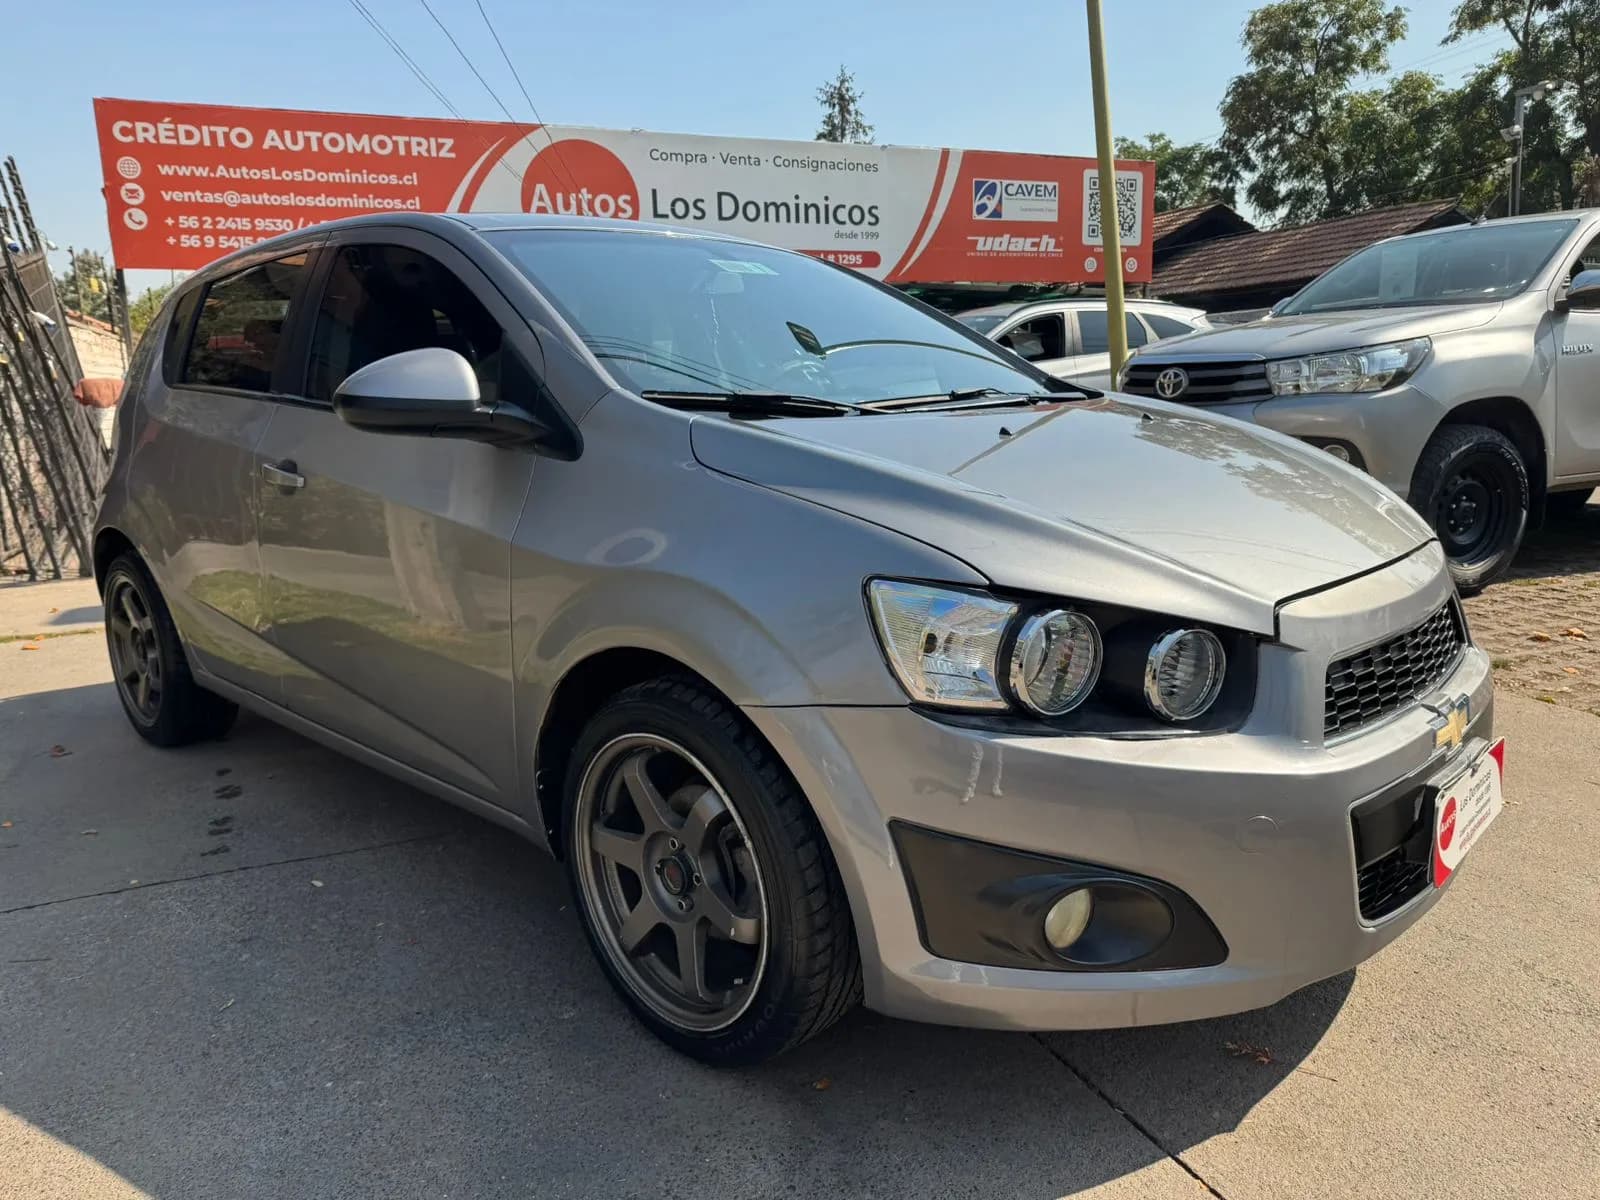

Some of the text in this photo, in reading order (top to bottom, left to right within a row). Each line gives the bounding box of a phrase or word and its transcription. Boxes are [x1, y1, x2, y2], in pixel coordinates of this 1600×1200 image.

[112, 117, 456, 158] CRÉDITO AUTOMOTRIZ
[649, 148, 879, 173] Compra Venta Consignaciones
[157, 163, 418, 185] www.AutosLosDominicos.cl
[160, 189, 421, 210] ventas@autoslosdominicos.cl
[1004, 183, 1057, 198] CAVEM
[529, 183, 633, 219] Autos
[651, 188, 880, 227] Los Dominicos
[178, 215, 199, 229] 56
[202, 216, 213, 229] 2
[215, 216, 251, 231] 2415
[255, 218, 293, 232] 9530
[180, 234, 201, 248] 56
[204, 235, 215, 248] 9
[218, 235, 253, 249] 5415
[834, 229, 879, 240] desde 1999
[967, 233, 1064, 252] udach
[838, 254, 863, 265] 1295
